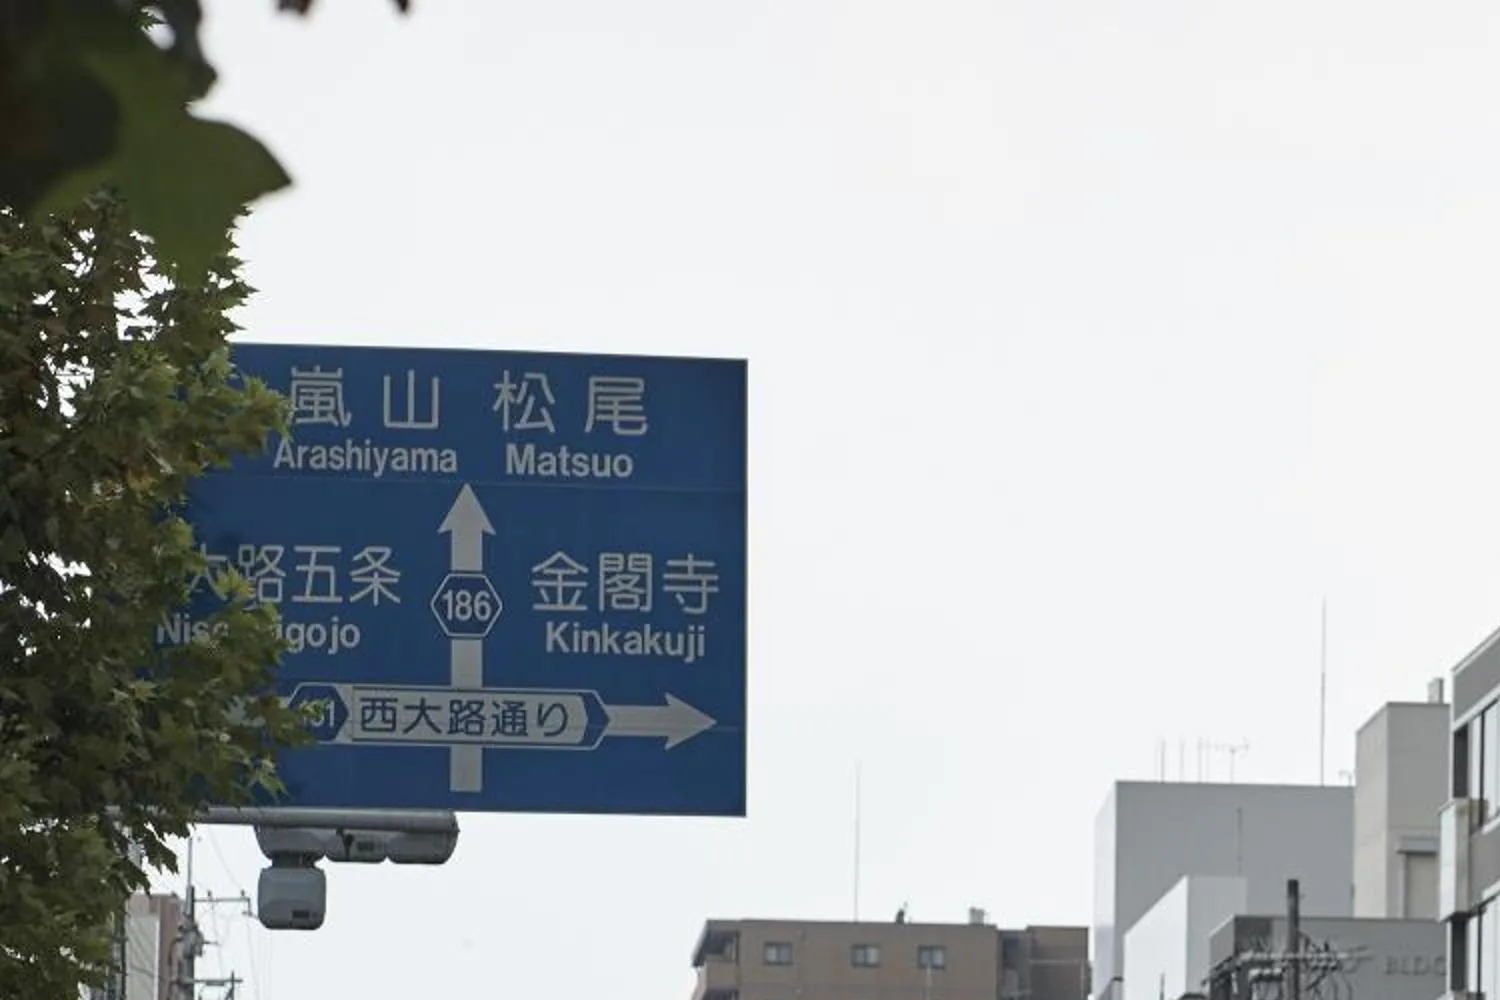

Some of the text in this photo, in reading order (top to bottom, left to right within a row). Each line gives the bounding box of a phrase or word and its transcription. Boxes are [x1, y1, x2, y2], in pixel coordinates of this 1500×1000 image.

[288, 366, 649, 436] 嵐山 松尾
[273, 438, 634, 478] Arashiyama Matsuo
[190, 543, 719, 615] 大路五条 金閣寺
[441, 589, 492, 622] 186
[546, 623, 705, 663] Kinkakuji
[359, 697, 569, 738] 西大路通り
